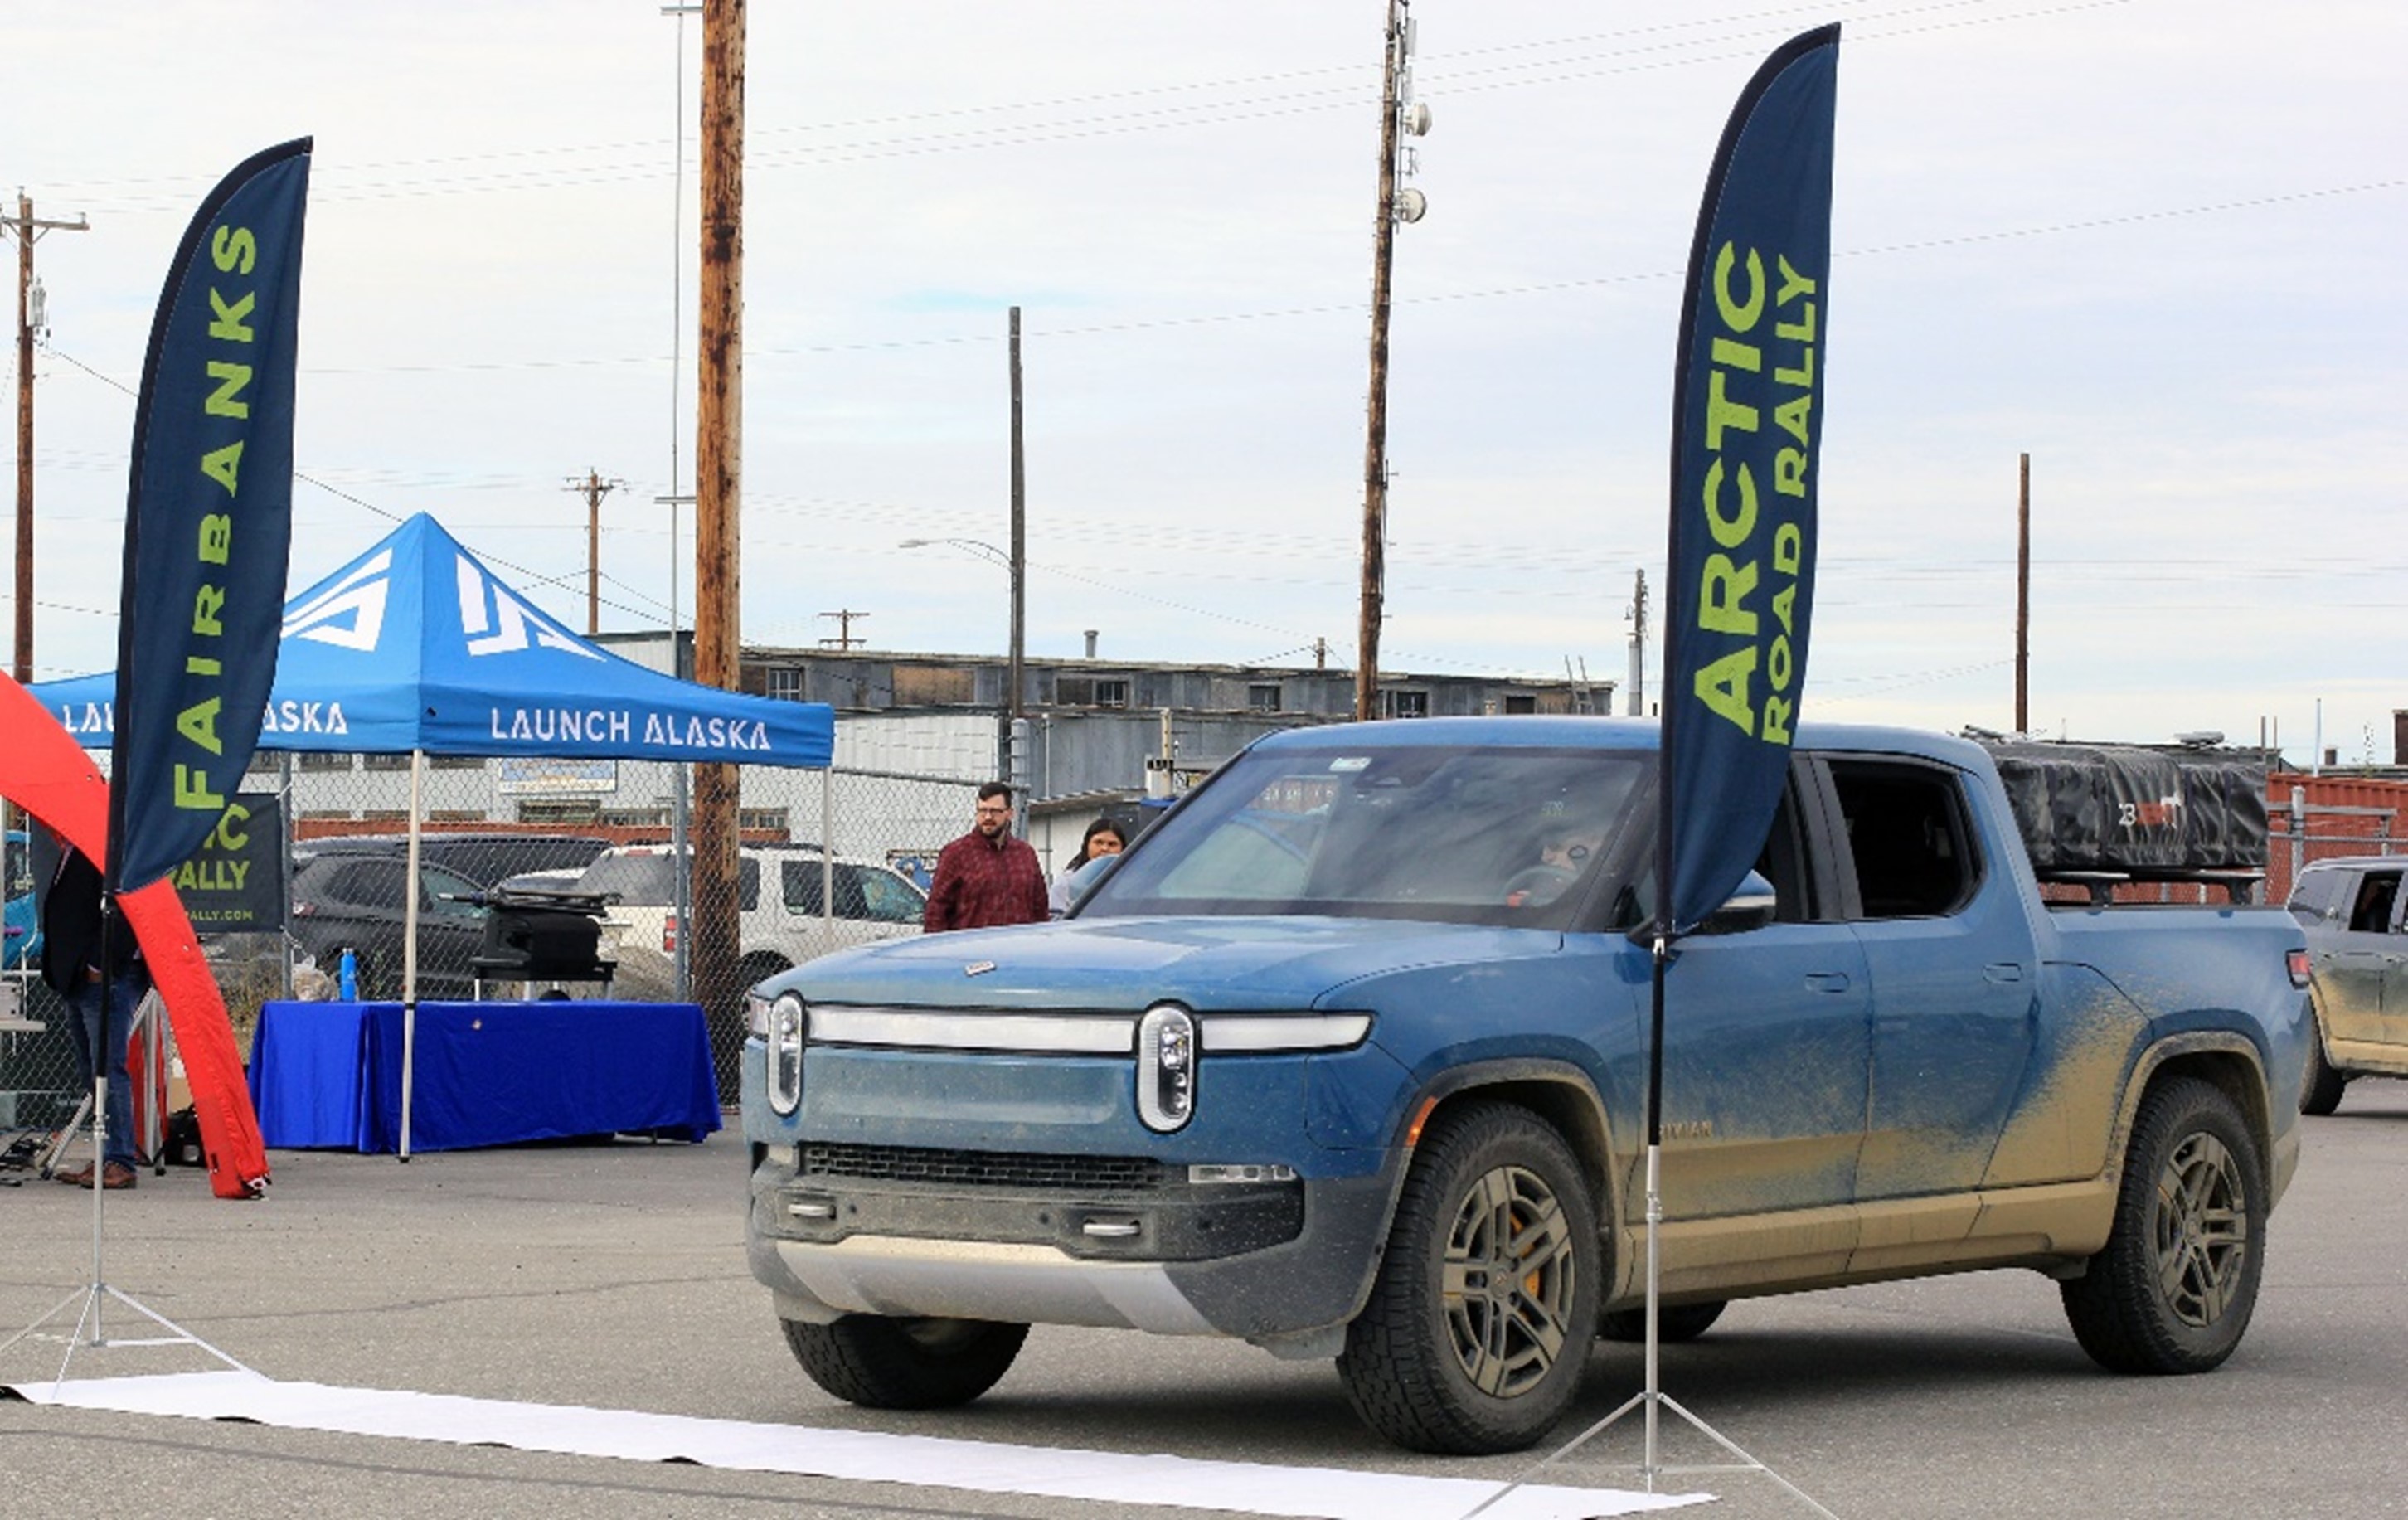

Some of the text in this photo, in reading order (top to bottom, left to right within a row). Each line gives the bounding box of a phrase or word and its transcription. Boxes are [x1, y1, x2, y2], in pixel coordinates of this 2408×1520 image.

[172, 226, 257, 810] FAIRBANKS
[1692, 240, 1767, 736] ARCTIC
[1761, 254, 1818, 746] ROAD RALLY
[491, 707, 772, 751] LAUNCH ALASKA
[167, 859, 251, 891] ALLY
[185, 910, 254, 921] ALLY.COM
